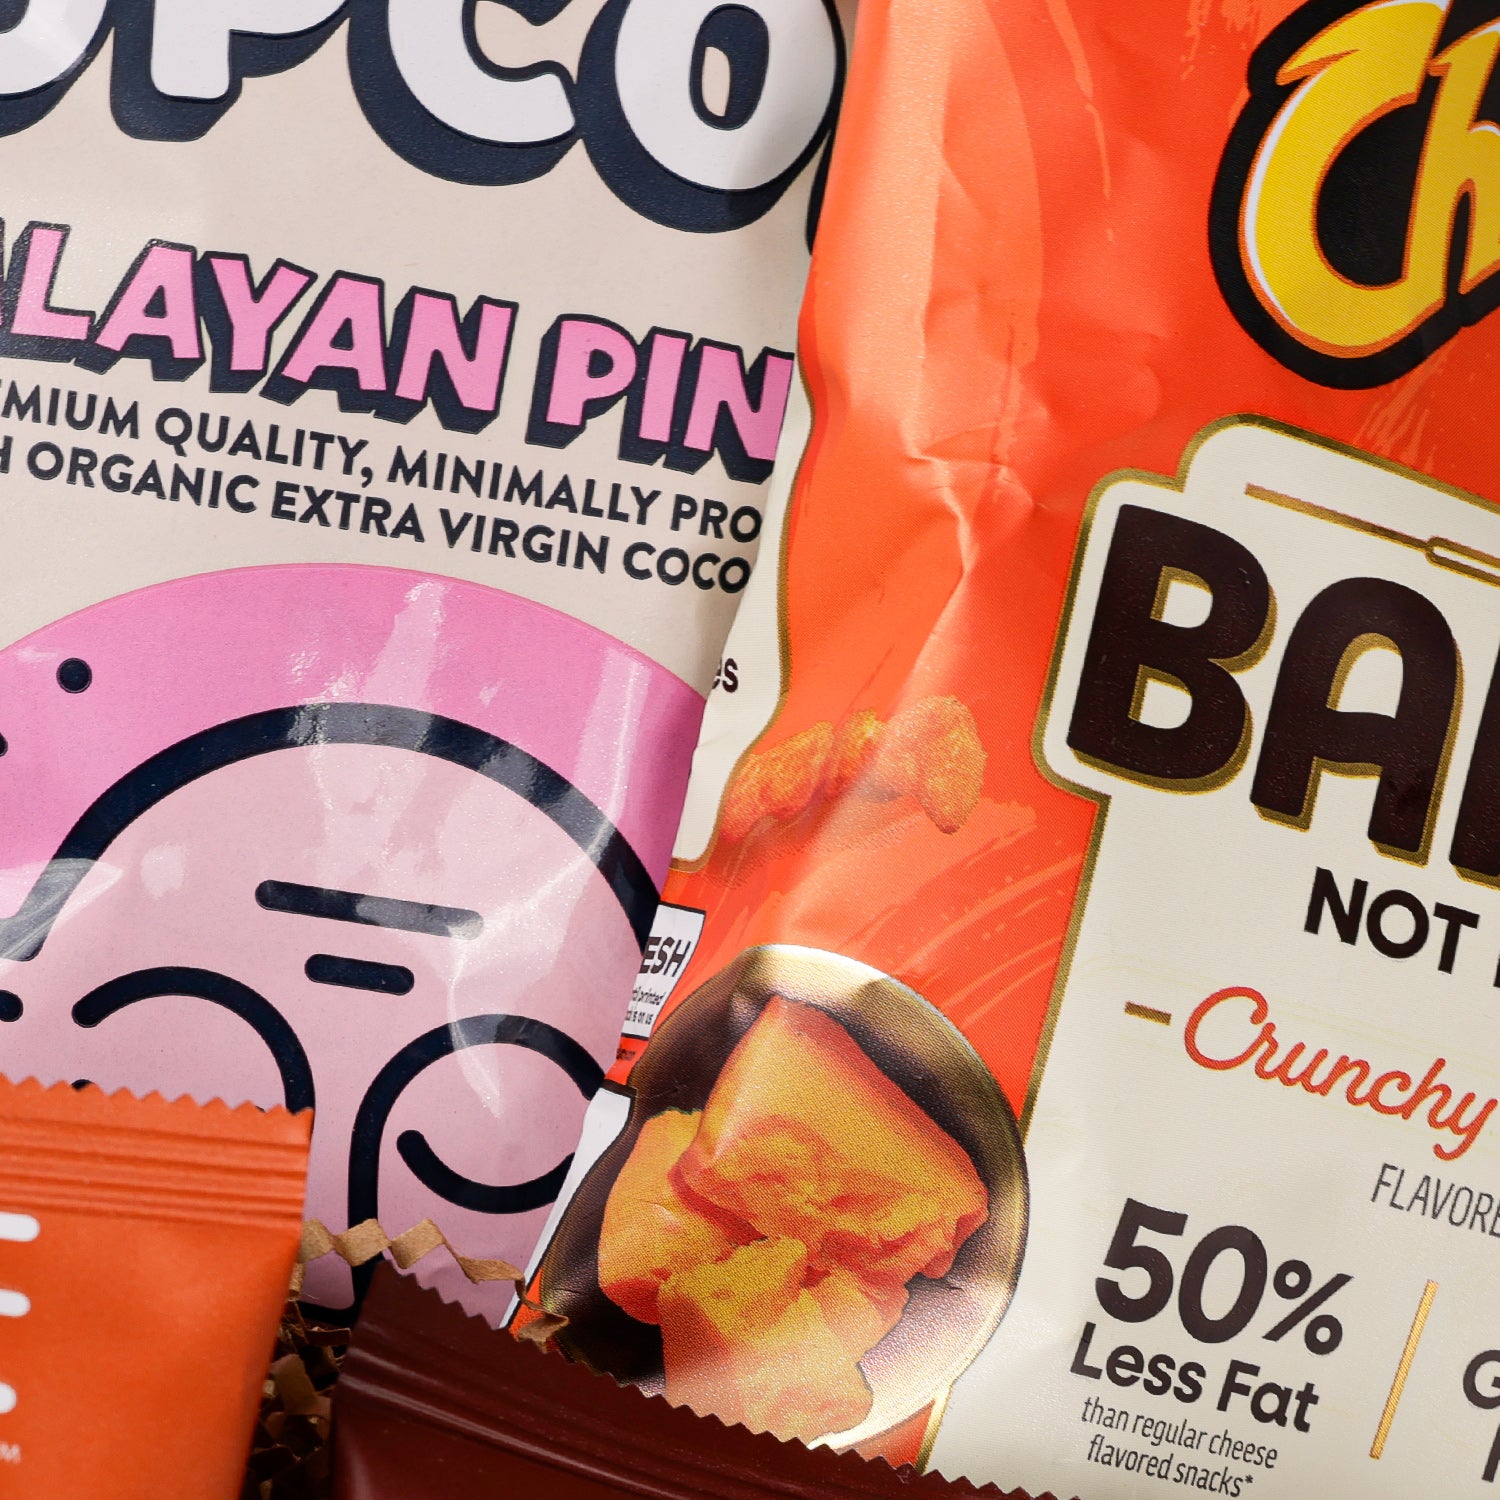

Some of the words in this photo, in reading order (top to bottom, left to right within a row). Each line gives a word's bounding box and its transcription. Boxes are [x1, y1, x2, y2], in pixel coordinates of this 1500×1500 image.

[0, 218, 519, 431] LAYAN
[526, 313, 794, 485] PIN
[0, 379, 139, 440] MIUM
[155, 407, 373, 487] QUALITY,
[391, 446, 661, 526] MINIMALLY
[671, 493, 762, 543] PRO
[27, 441, 258, 515] ORGANIC
[271, 486, 426, 544] EXTRA
[439, 514, 609, 574] VIRGIN
[623, 541, 751, 593] COCO
[1303, 866, 1480, 976] NOT
[1183, 986, 1498, 1163] Crunchy
[1095, 1197, 1354, 1356] 50%
[1069, 1323, 1205, 1403] Less
[1213, 1357, 1320, 1433] Fat
[1081, 1396, 1130, 1432] than
[1132, 1414, 1207, 1447] regular
[1208, 1429, 1278, 1469] cheese
[1087, 1434, 1174, 1480] flavored
